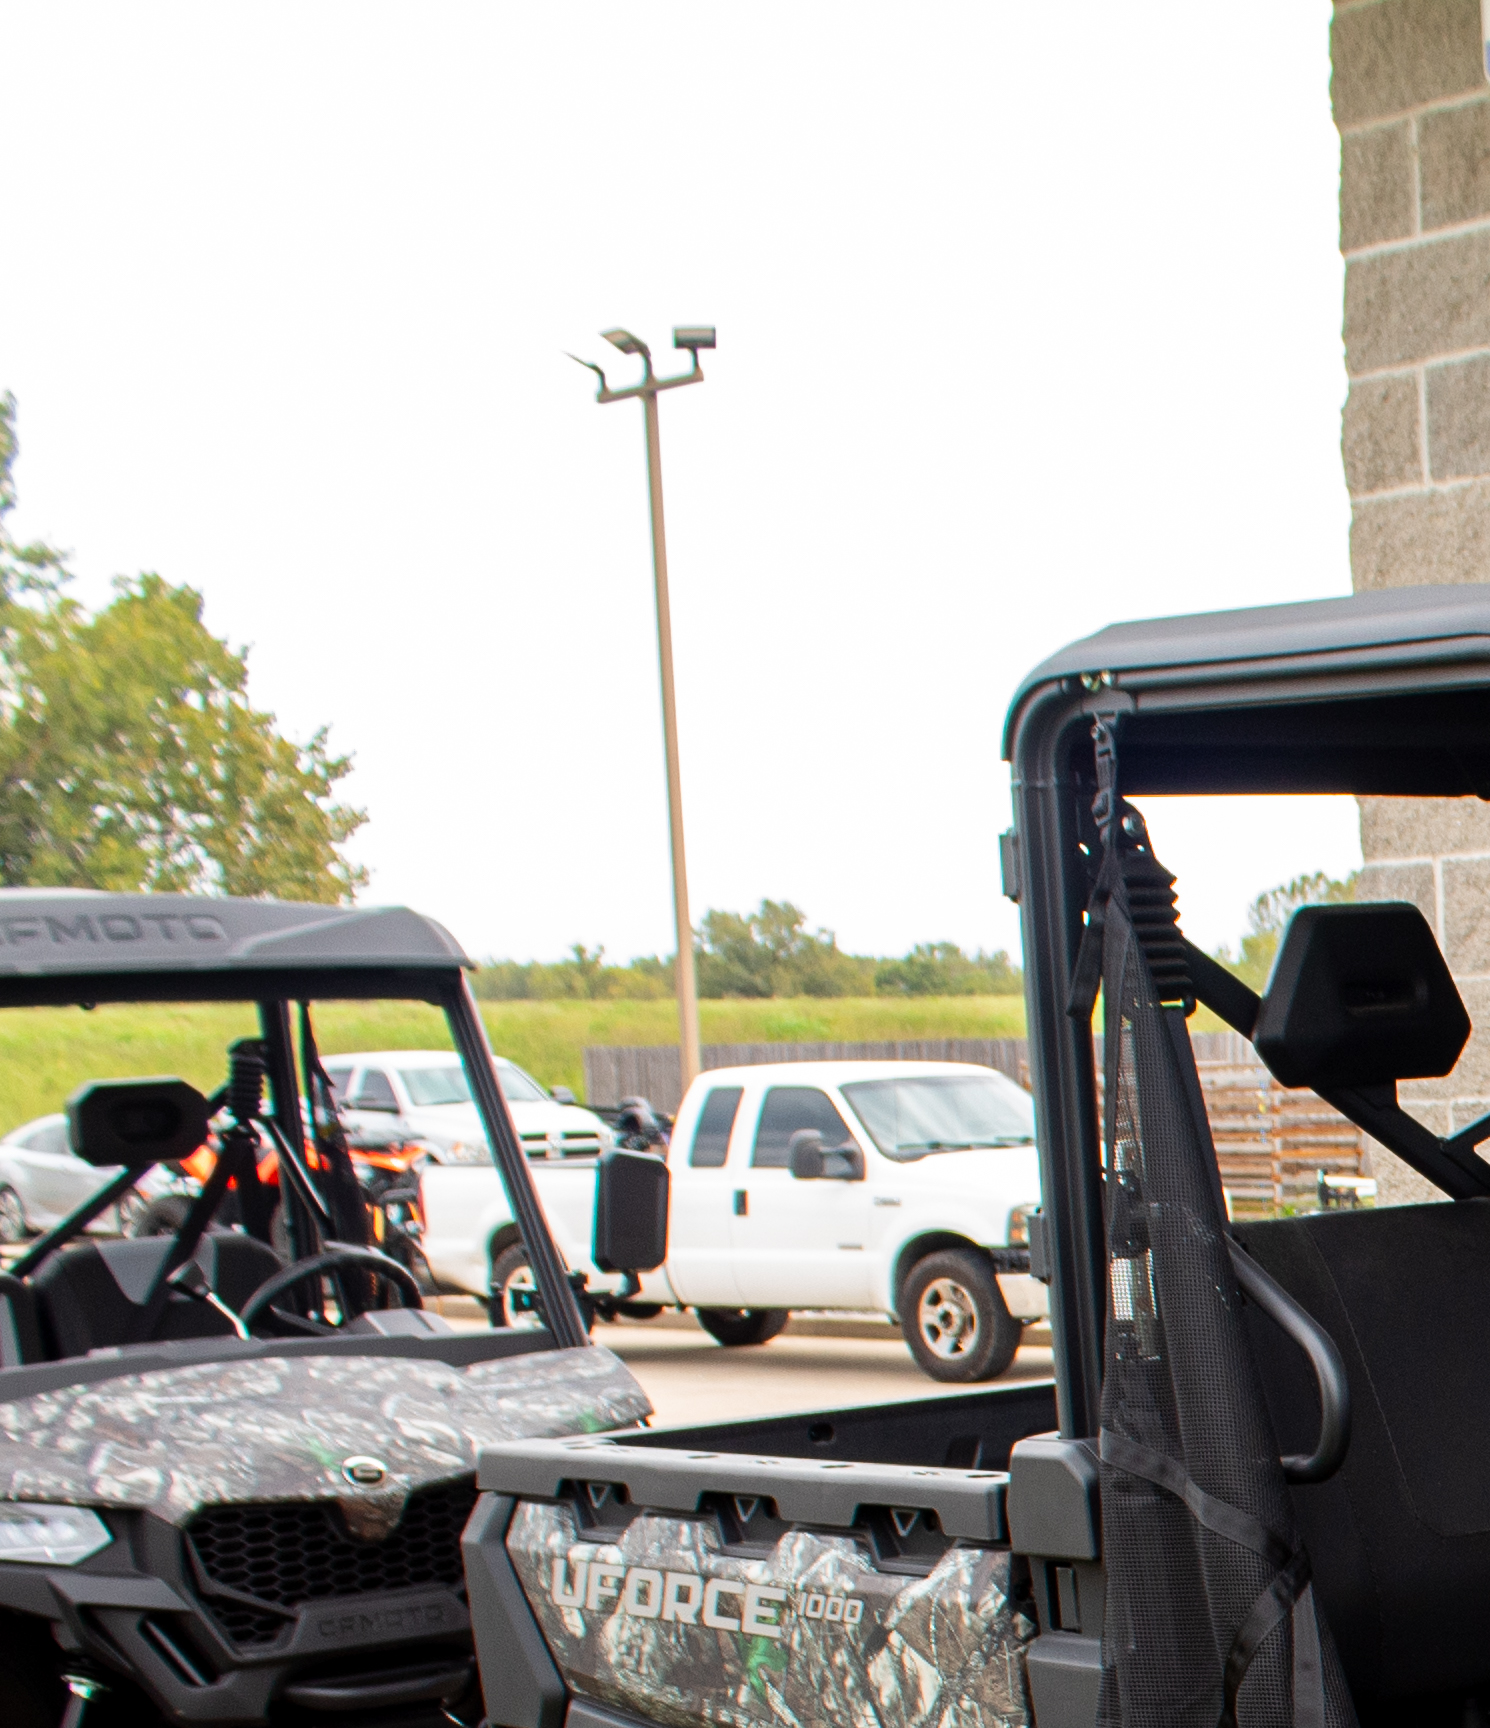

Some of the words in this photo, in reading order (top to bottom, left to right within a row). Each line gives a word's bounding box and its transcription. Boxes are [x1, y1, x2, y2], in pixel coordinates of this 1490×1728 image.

[0, 912, 228, 946] FMOTO
[551, 1557, 788, 1639] UFORCE
[800, 1591, 864, 1625] 1000
